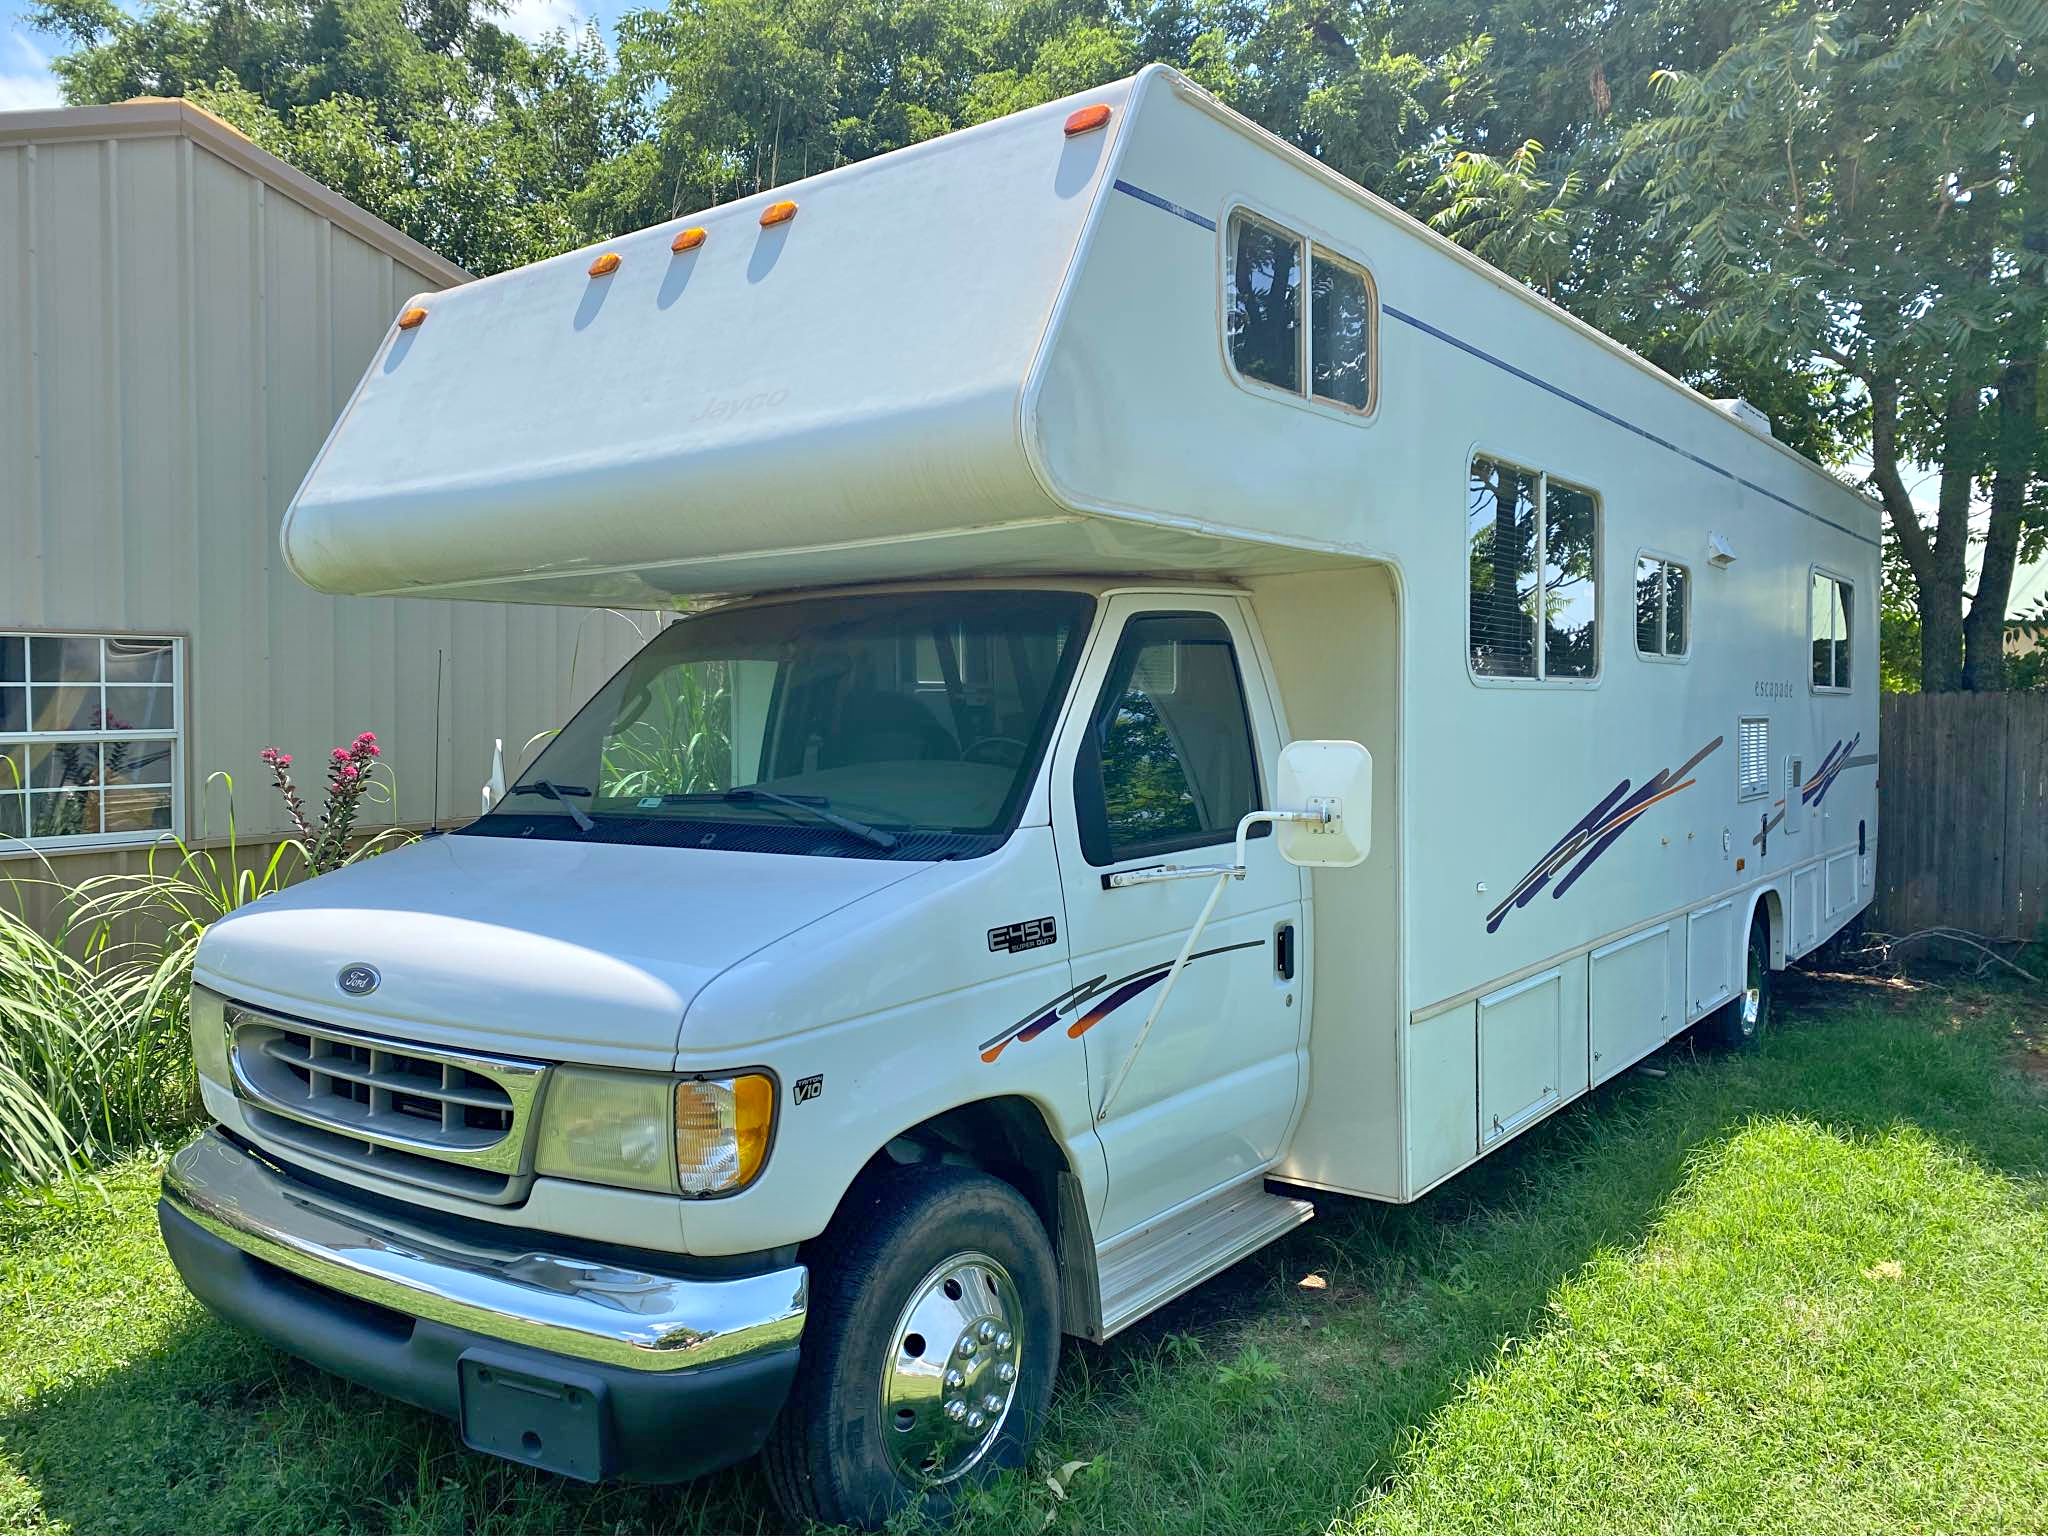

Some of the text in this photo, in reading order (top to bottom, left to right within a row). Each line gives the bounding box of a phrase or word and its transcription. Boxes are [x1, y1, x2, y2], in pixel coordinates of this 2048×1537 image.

[1755, 680, 1793, 702] escapade
[1011, 936, 1055, 952] SUPER DUTY
[345, 971, 369, 988] Ford
[798, 1076, 823, 1087] TRITON
[794, 1082, 821, 1104] V10
